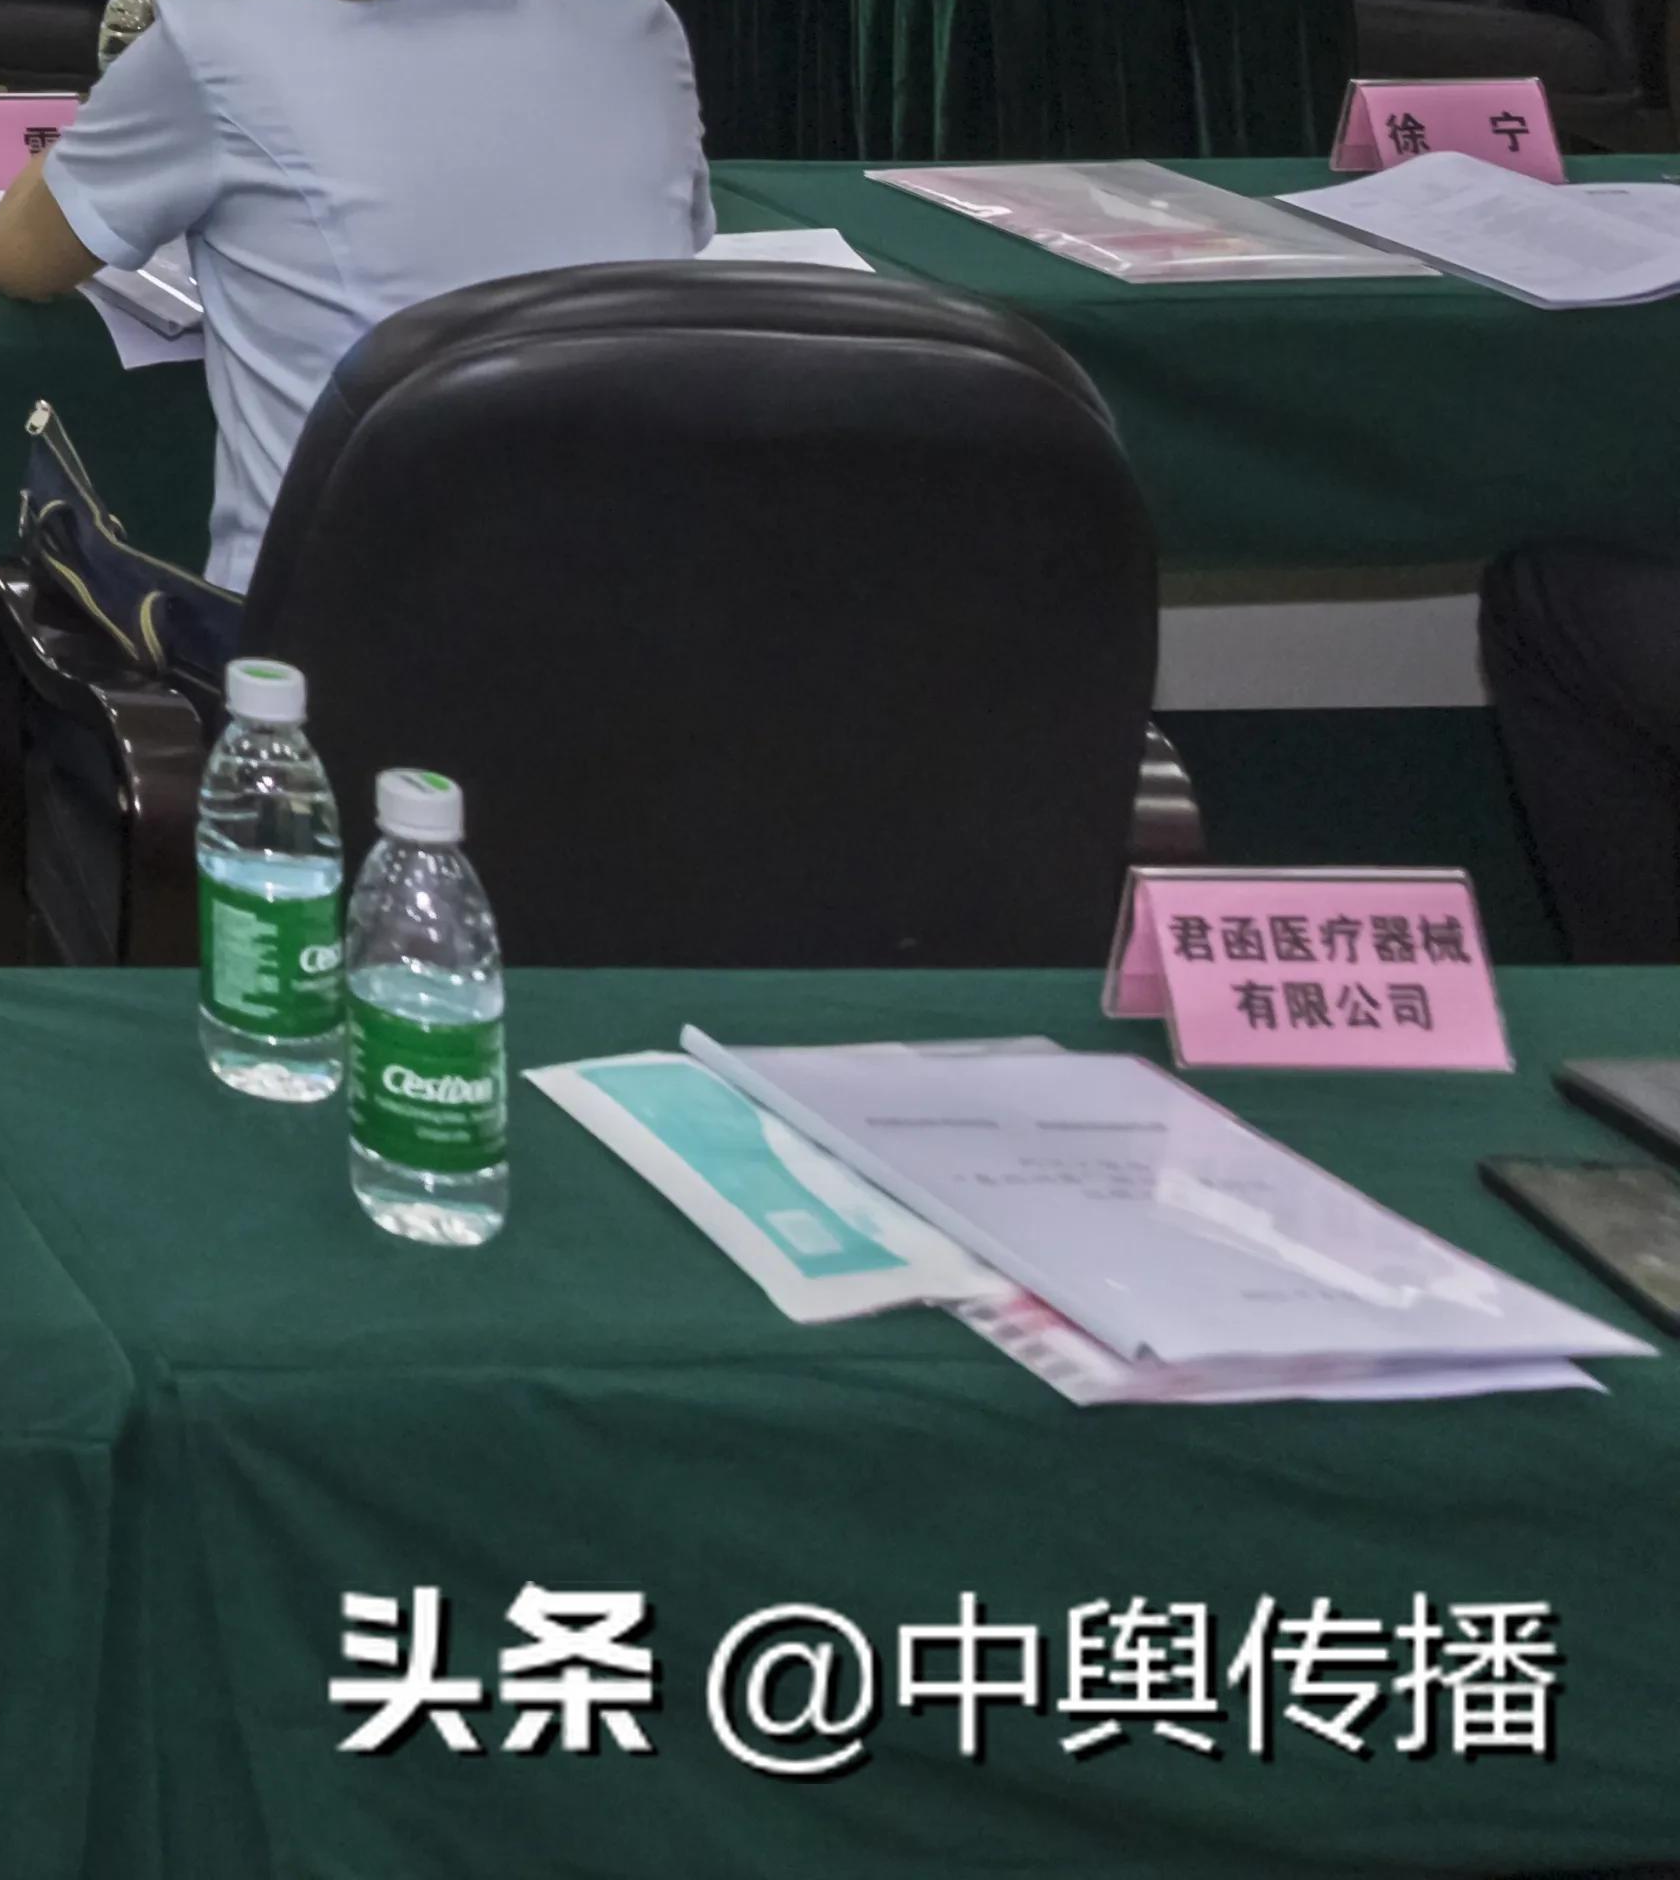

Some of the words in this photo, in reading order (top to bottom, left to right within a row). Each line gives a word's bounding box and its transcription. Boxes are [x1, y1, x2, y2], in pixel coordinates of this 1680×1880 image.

[1170, 912, 1473, 965] 君函医疗器械
[1235, 981, 1434, 1031] 有限公司
